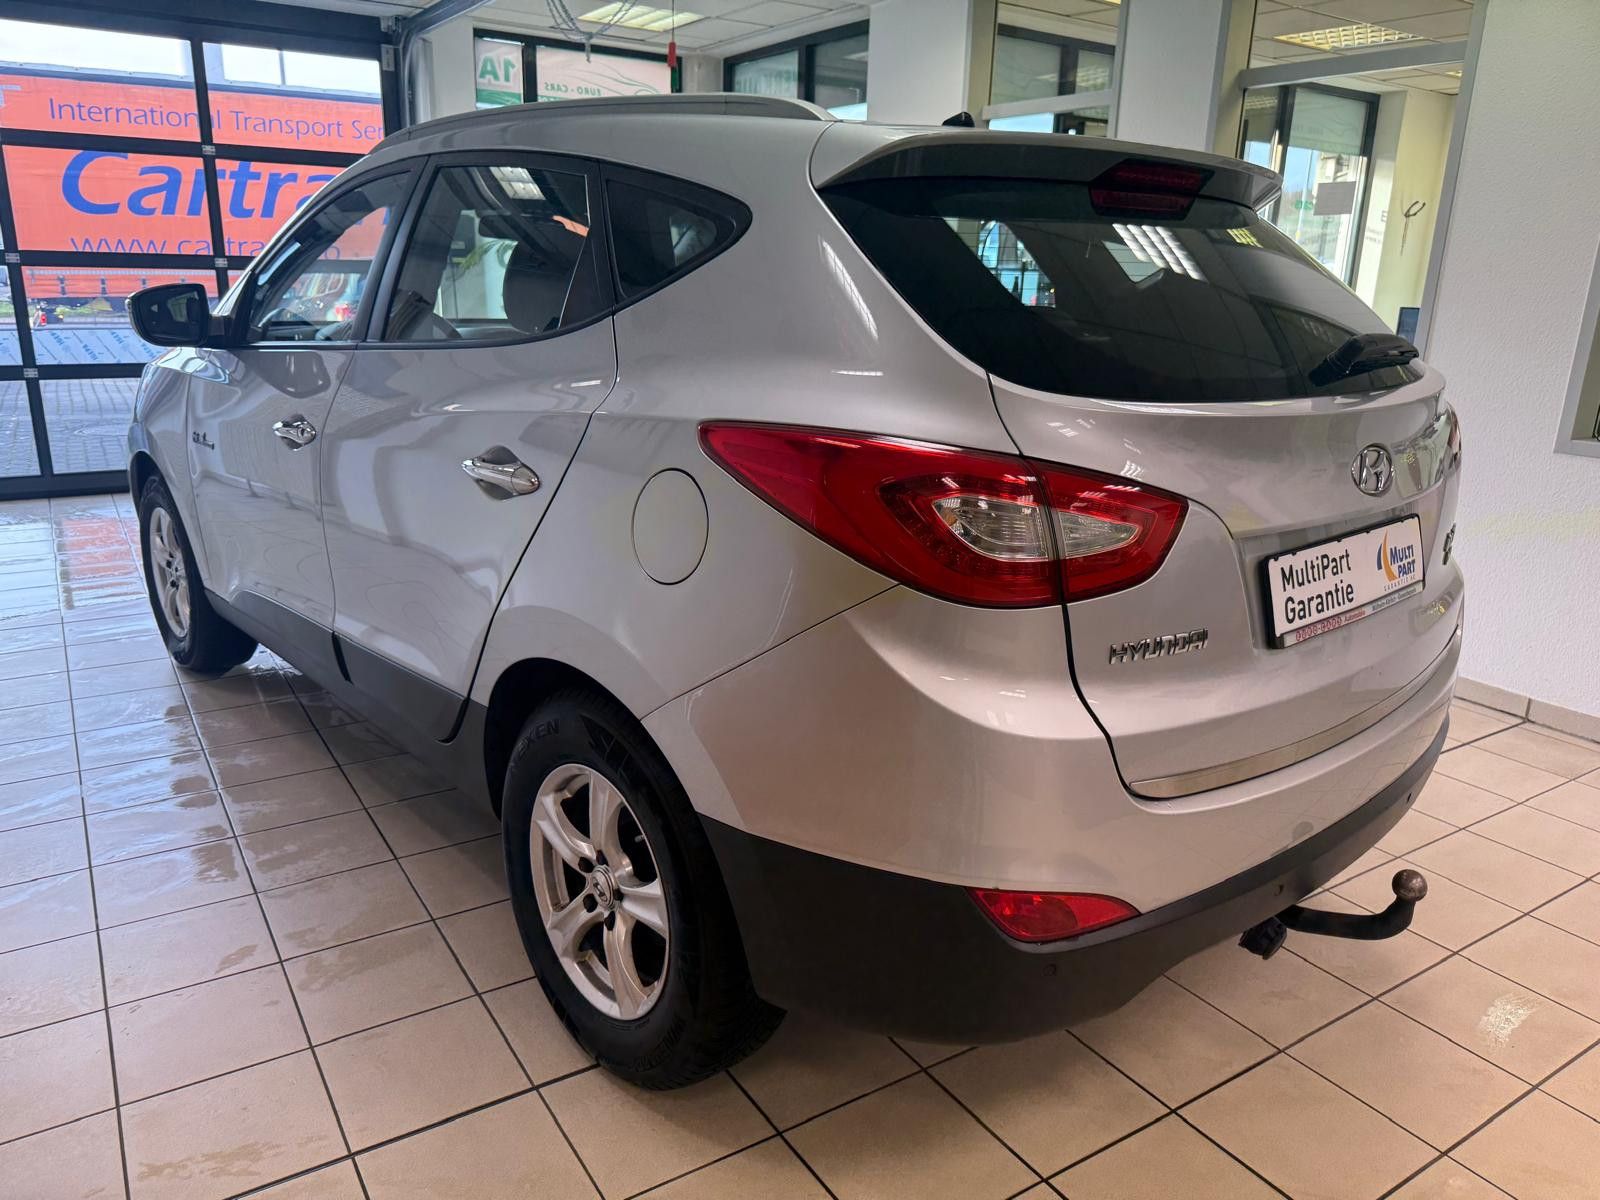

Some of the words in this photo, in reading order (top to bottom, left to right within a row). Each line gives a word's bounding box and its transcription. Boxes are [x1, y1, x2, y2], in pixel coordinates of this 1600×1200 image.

[229, 110, 344, 140] Transport
[1280, 548, 1352, 592] MultiPart
[1397, 558, 1416, 578] PART
[1284, 579, 1354, 624] Garantie
[1109, 628, 1209, 665] HYUNDAI
